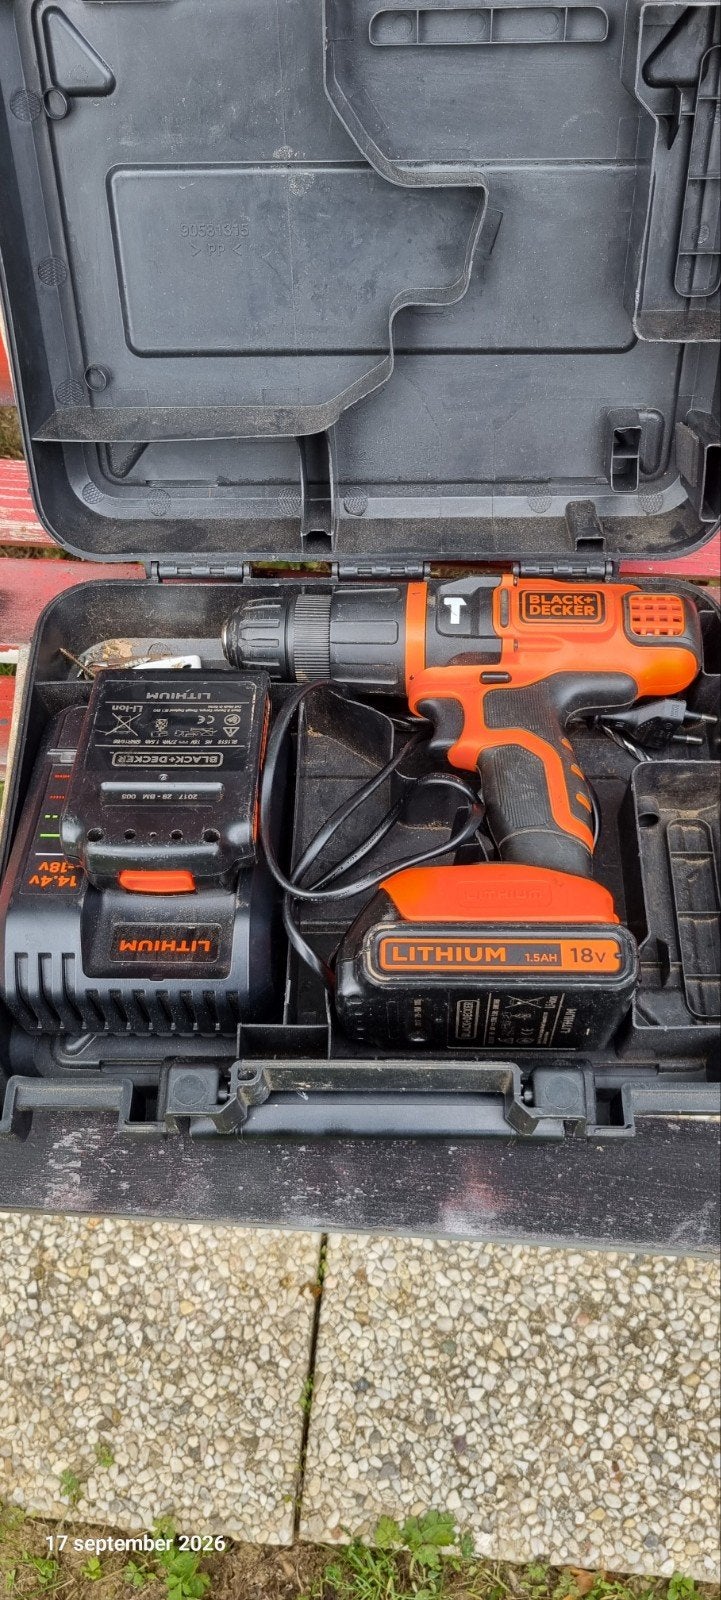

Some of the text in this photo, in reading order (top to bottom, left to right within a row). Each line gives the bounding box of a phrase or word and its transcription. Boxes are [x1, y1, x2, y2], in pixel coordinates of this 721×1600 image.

[529, 594, 593, 605] BLACK+
[529, 604, 595, 616] DECKER
[146, 692, 211, 700] LITHIUM
[116, 754, 219, 765] BLACK+DECKER
[118, 939, 212, 953] LITHIUM
[391, 946, 507, 962] LITHIUM
[524, 953, 558, 963] 1.5AH
